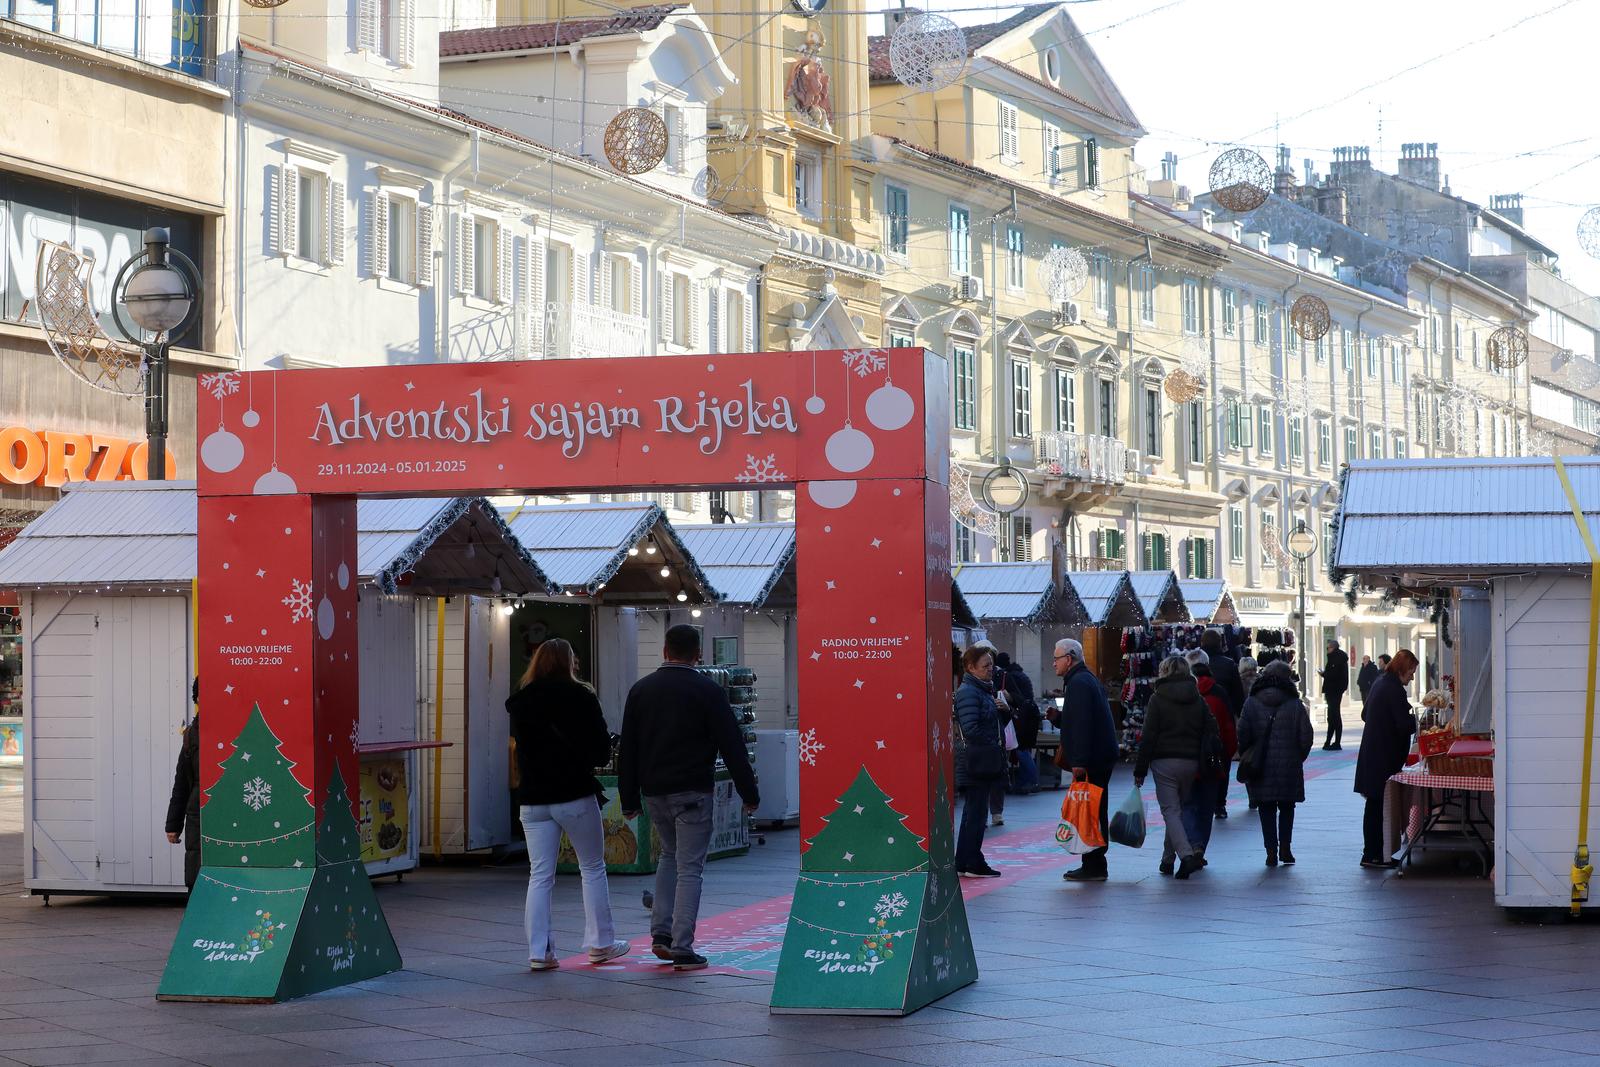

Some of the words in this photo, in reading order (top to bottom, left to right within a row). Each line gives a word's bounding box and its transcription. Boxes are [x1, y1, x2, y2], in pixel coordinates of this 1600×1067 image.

[308, 387, 512, 445] Adventski
[524, 401, 641, 459] sajam
[653, 378, 798, 455] Rijeka
[821, 639, 858, 647] RADNO
[860, 638, 902, 646] VRIJEME
[220, 646, 252, 654] RADNO
[254, 645, 292, 653] VRIJEME
[192, 939, 236, 952] Rijeka
[804, 949, 851, 963] Rijeka
